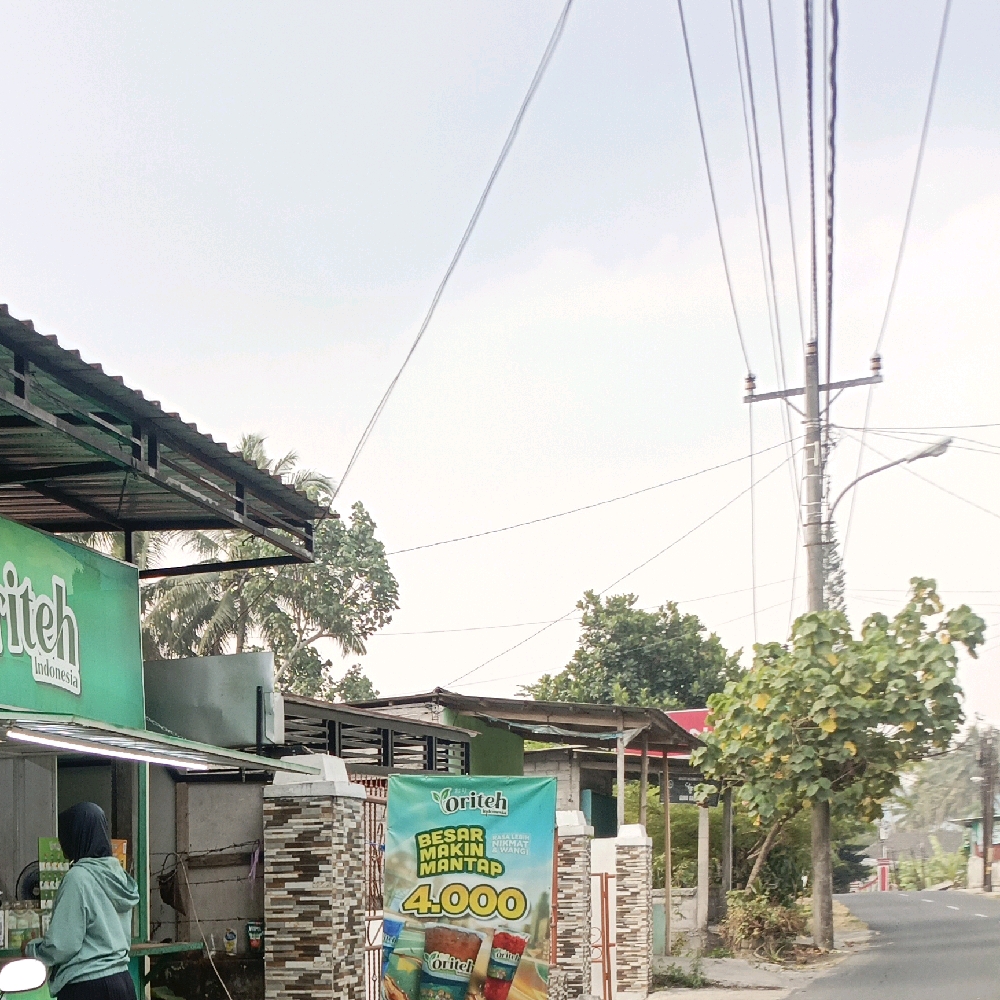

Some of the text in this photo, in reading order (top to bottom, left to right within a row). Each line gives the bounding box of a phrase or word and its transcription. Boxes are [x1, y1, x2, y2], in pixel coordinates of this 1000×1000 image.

[34, 656, 78, 689] Indonesia
[417, 827, 484, 848] BESAR
[492, 840, 529, 848] NIKMAT
[420, 842, 484, 861] MAKIN
[499, 847, 530, 855] WANGI
[420, 857, 503, 876] MANTAP
[402, 883, 527, 921] 4.000
